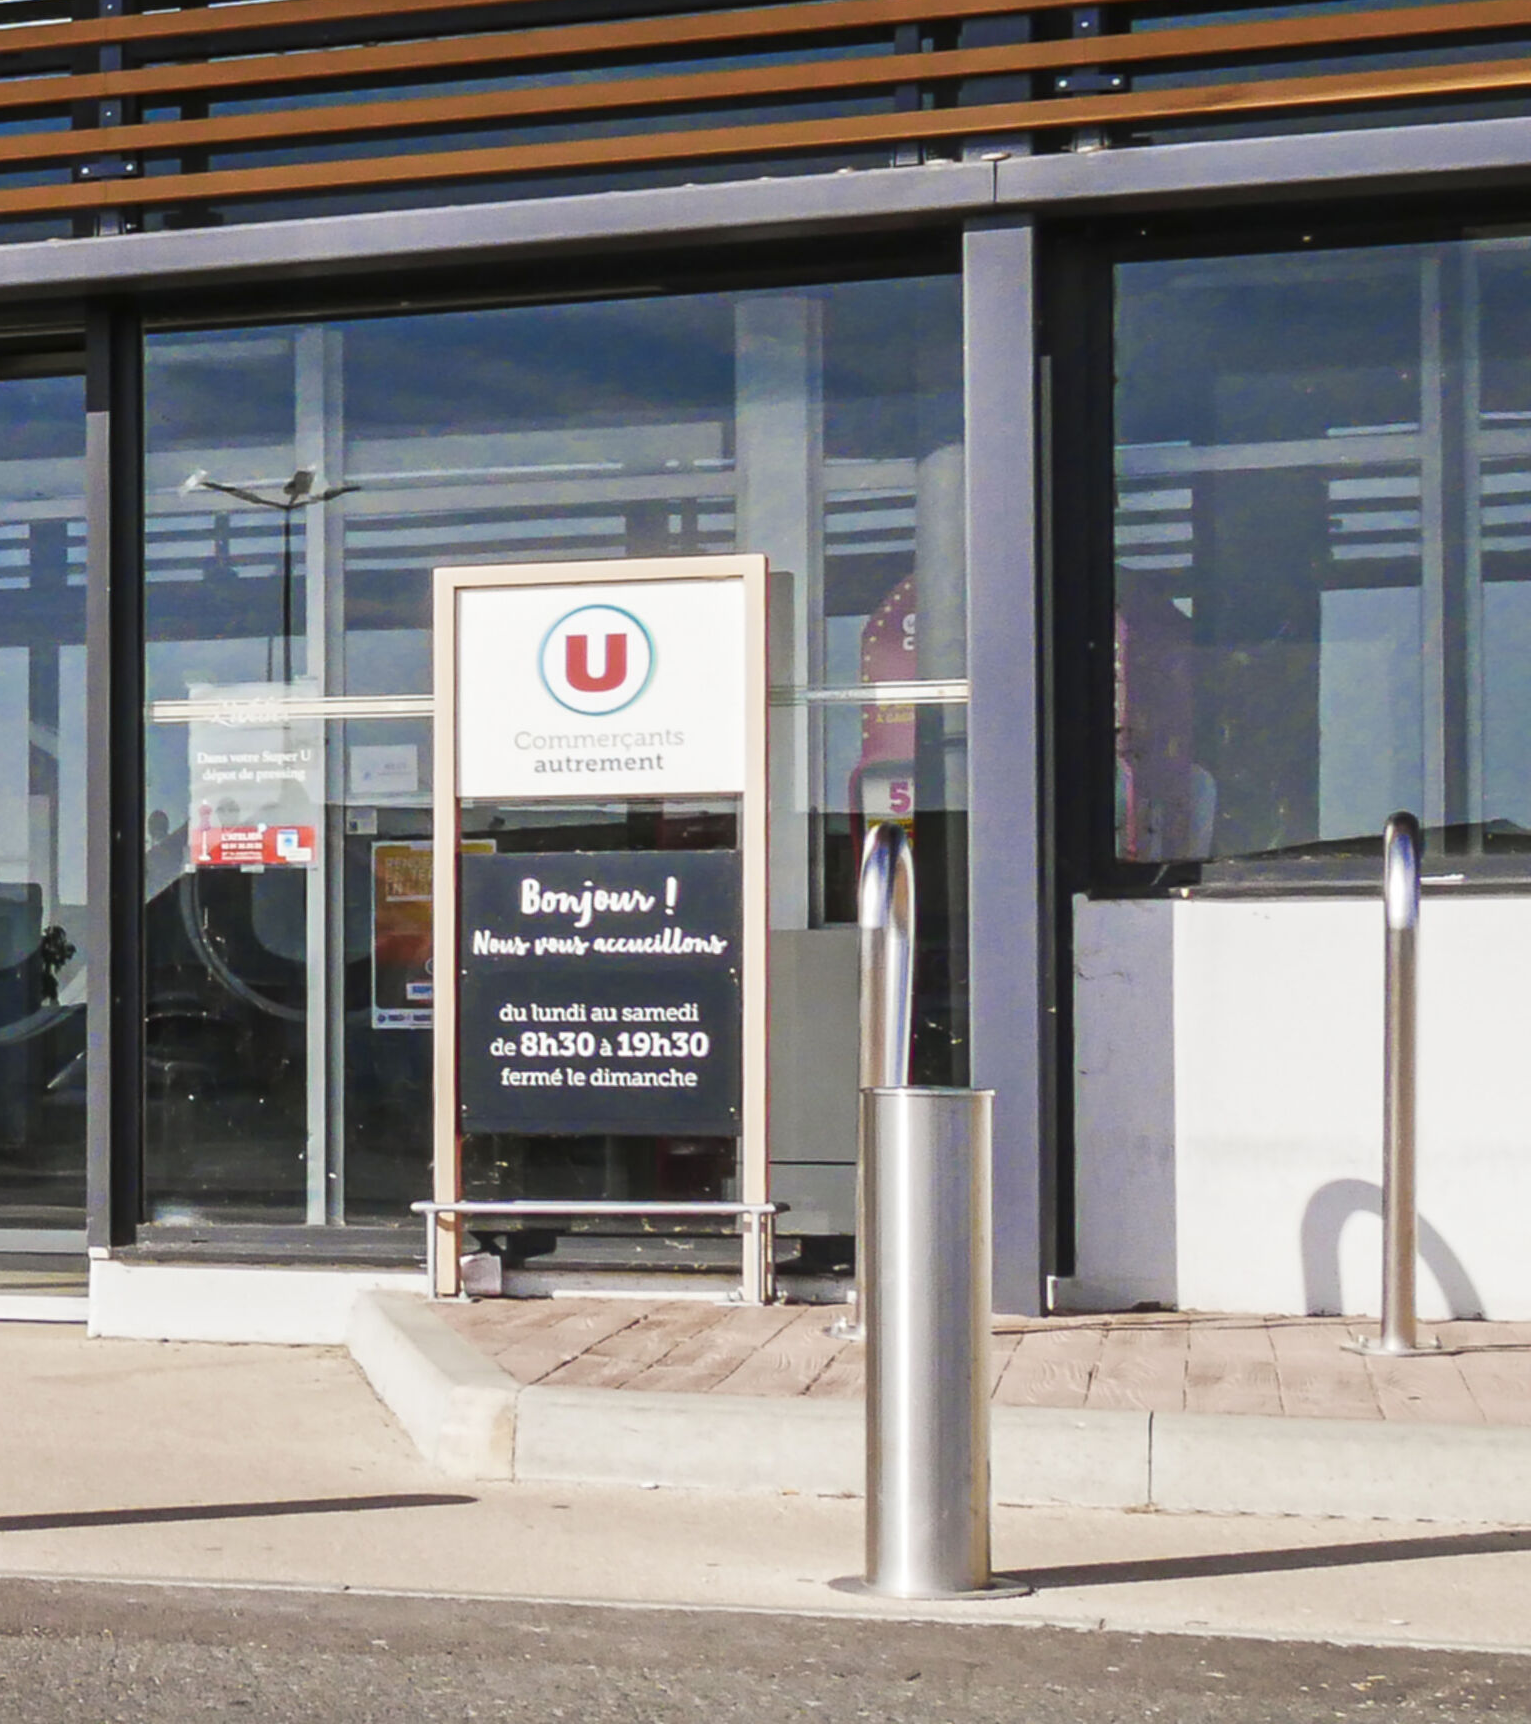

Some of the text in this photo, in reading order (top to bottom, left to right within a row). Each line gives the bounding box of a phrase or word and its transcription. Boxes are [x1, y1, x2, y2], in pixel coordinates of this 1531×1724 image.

[566, 633, 627, 692] U
[514, 729, 685, 750] Commerçants
[262, 750, 298, 765] Super
[300, 748, 311, 762] U
[534, 753, 664, 773] autrement
[520, 876, 677, 928] Bonjour !
[473, 927, 728, 956] Nous vous accueillons
[499, 1003, 699, 1021] du lundi au samedi
[490, 1032, 709, 1057] de 8h30 à 19h30
[501, 1068, 698, 1087] fermé le dimanche
